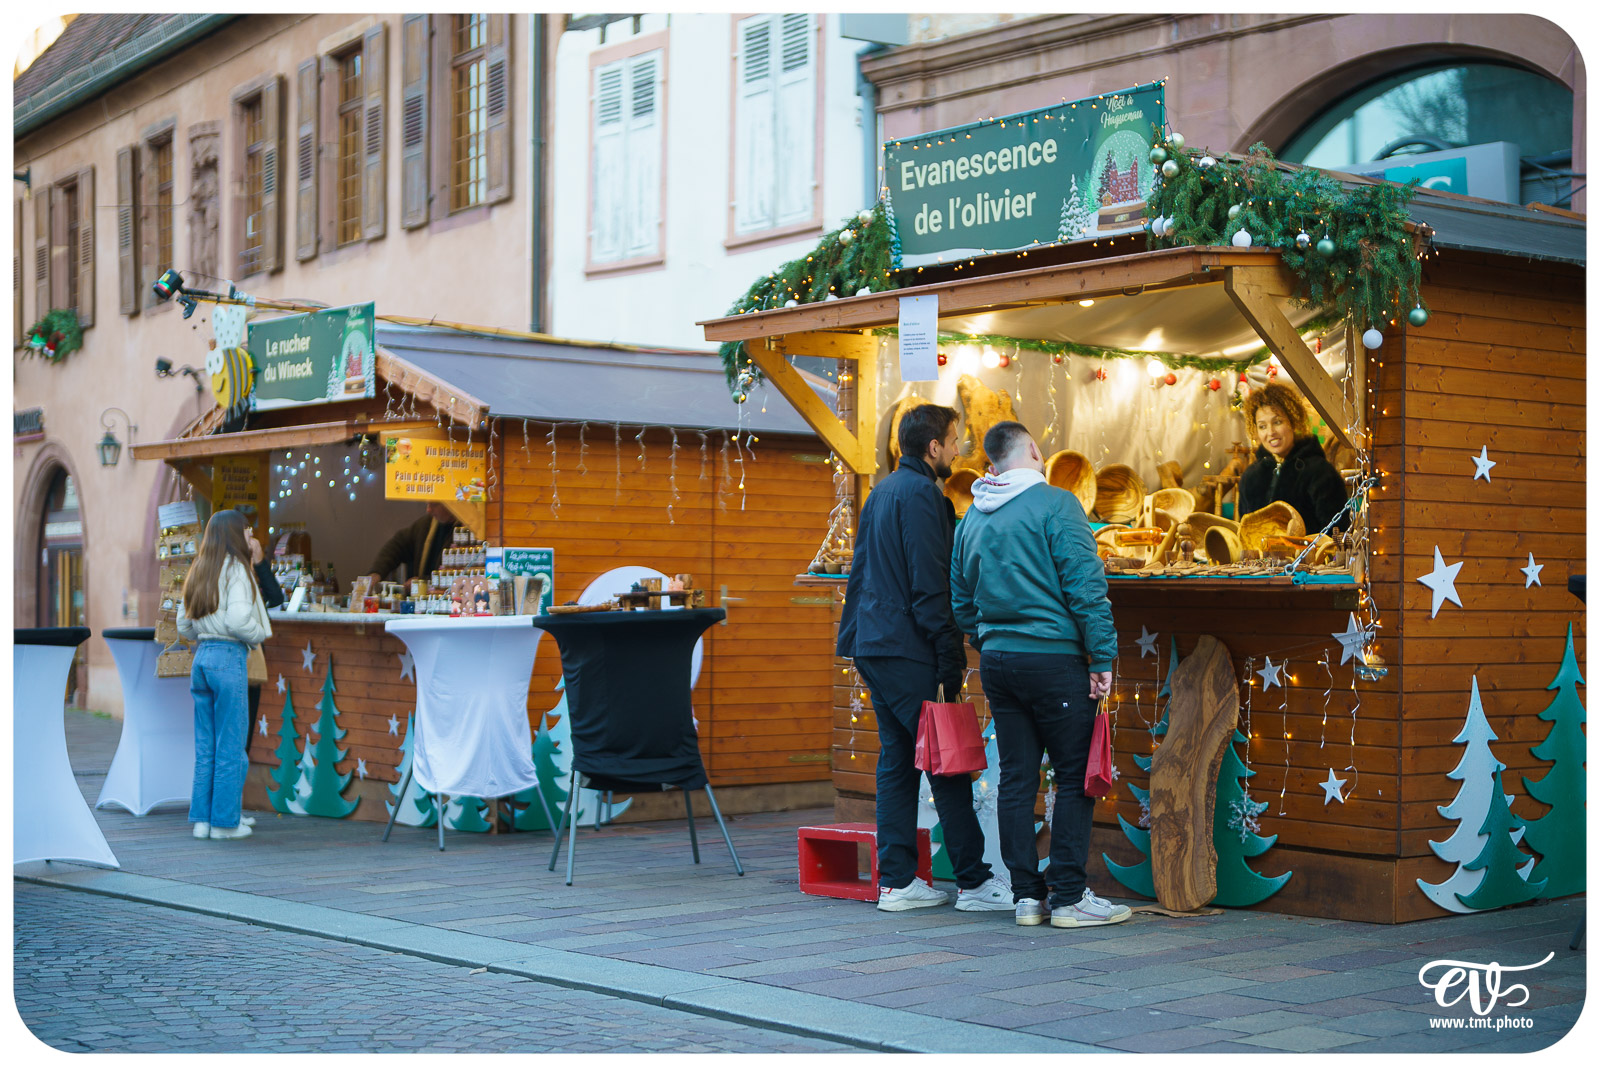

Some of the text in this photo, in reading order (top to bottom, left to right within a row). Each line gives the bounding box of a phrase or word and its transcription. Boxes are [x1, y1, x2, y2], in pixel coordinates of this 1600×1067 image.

[1127, 94, 1134, 106] à
[1100, 109, 1144, 129] Haguenau
[901, 139, 1058, 191] Evanescence
[914, 188, 1037, 236] de l'olivier
[265, 333, 312, 358] Le rucher
[263, 357, 314, 383] du Wineck
[425, 445, 485, 459] Vin blanc chaud
[440, 459, 469, 469] au miel
[395, 471, 446, 484] Pain d'épices
[405, 483, 434, 494] au miel
